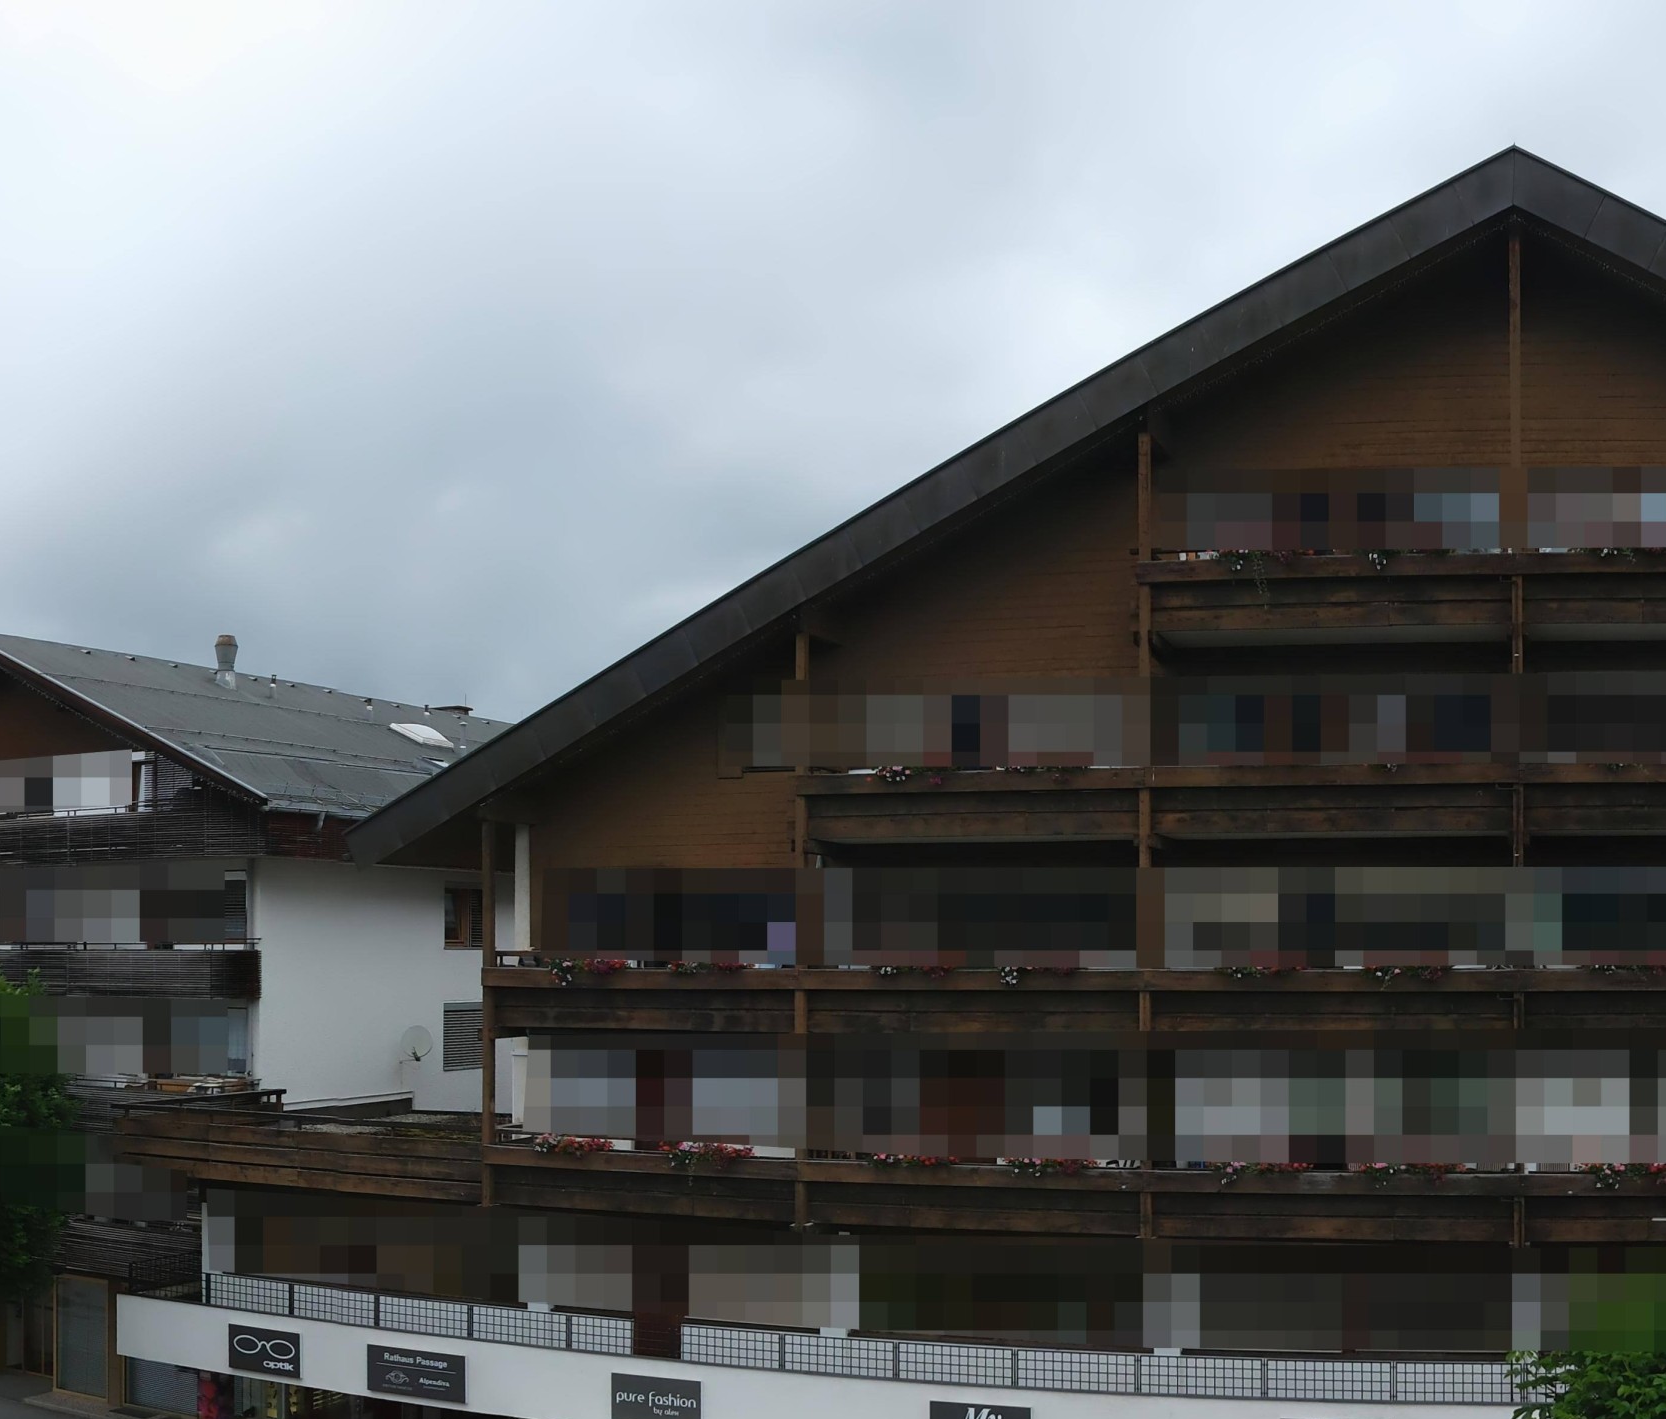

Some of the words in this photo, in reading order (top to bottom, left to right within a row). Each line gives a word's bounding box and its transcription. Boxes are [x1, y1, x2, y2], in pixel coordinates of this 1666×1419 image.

[263, 1360, 293, 1371] optik
[384, 1352, 414, 1364] Rathaus
[416, 1356, 447, 1369] Passage
[419, 1377, 450, 1387] Alpendiva
[616, 1390, 645, 1405] pure
[648, 1390, 697, 1409] fashion
[653, 1406, 662, 1416] by
